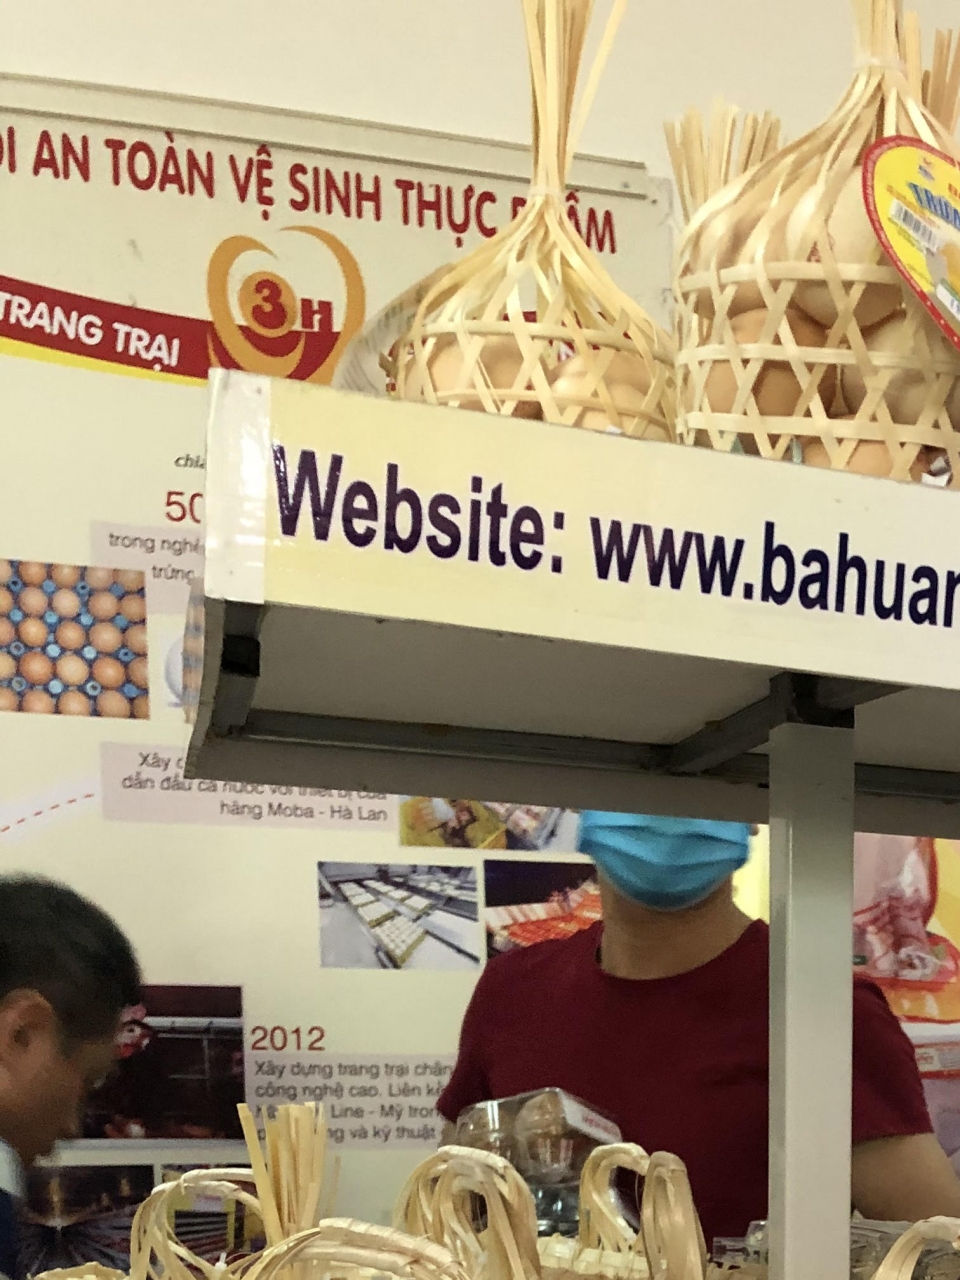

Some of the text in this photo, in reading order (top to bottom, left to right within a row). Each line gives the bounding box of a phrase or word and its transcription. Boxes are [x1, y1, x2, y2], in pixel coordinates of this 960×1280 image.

[33, 130, 90, 182] AN
[104, 131, 215, 199] TOÀN
[229, 144, 274, 221] VỆ
[288, 163, 381, 222] SINH
[395, 179, 497, 248] THỰC
[0, 291, 180, 371] TRANG TRẠI
[272, 444, 565, 573] Website:
[109, 533, 155, 554] trong
[330, 805, 353, 820] Hà
[358, 806, 388, 821] Lan
[251, 1026, 325, 1051] 2012
[255, 1060, 286, 1079] Xây
[290, 1062, 333, 1080] dựng
[338, 1063, 380, 1080] trang
